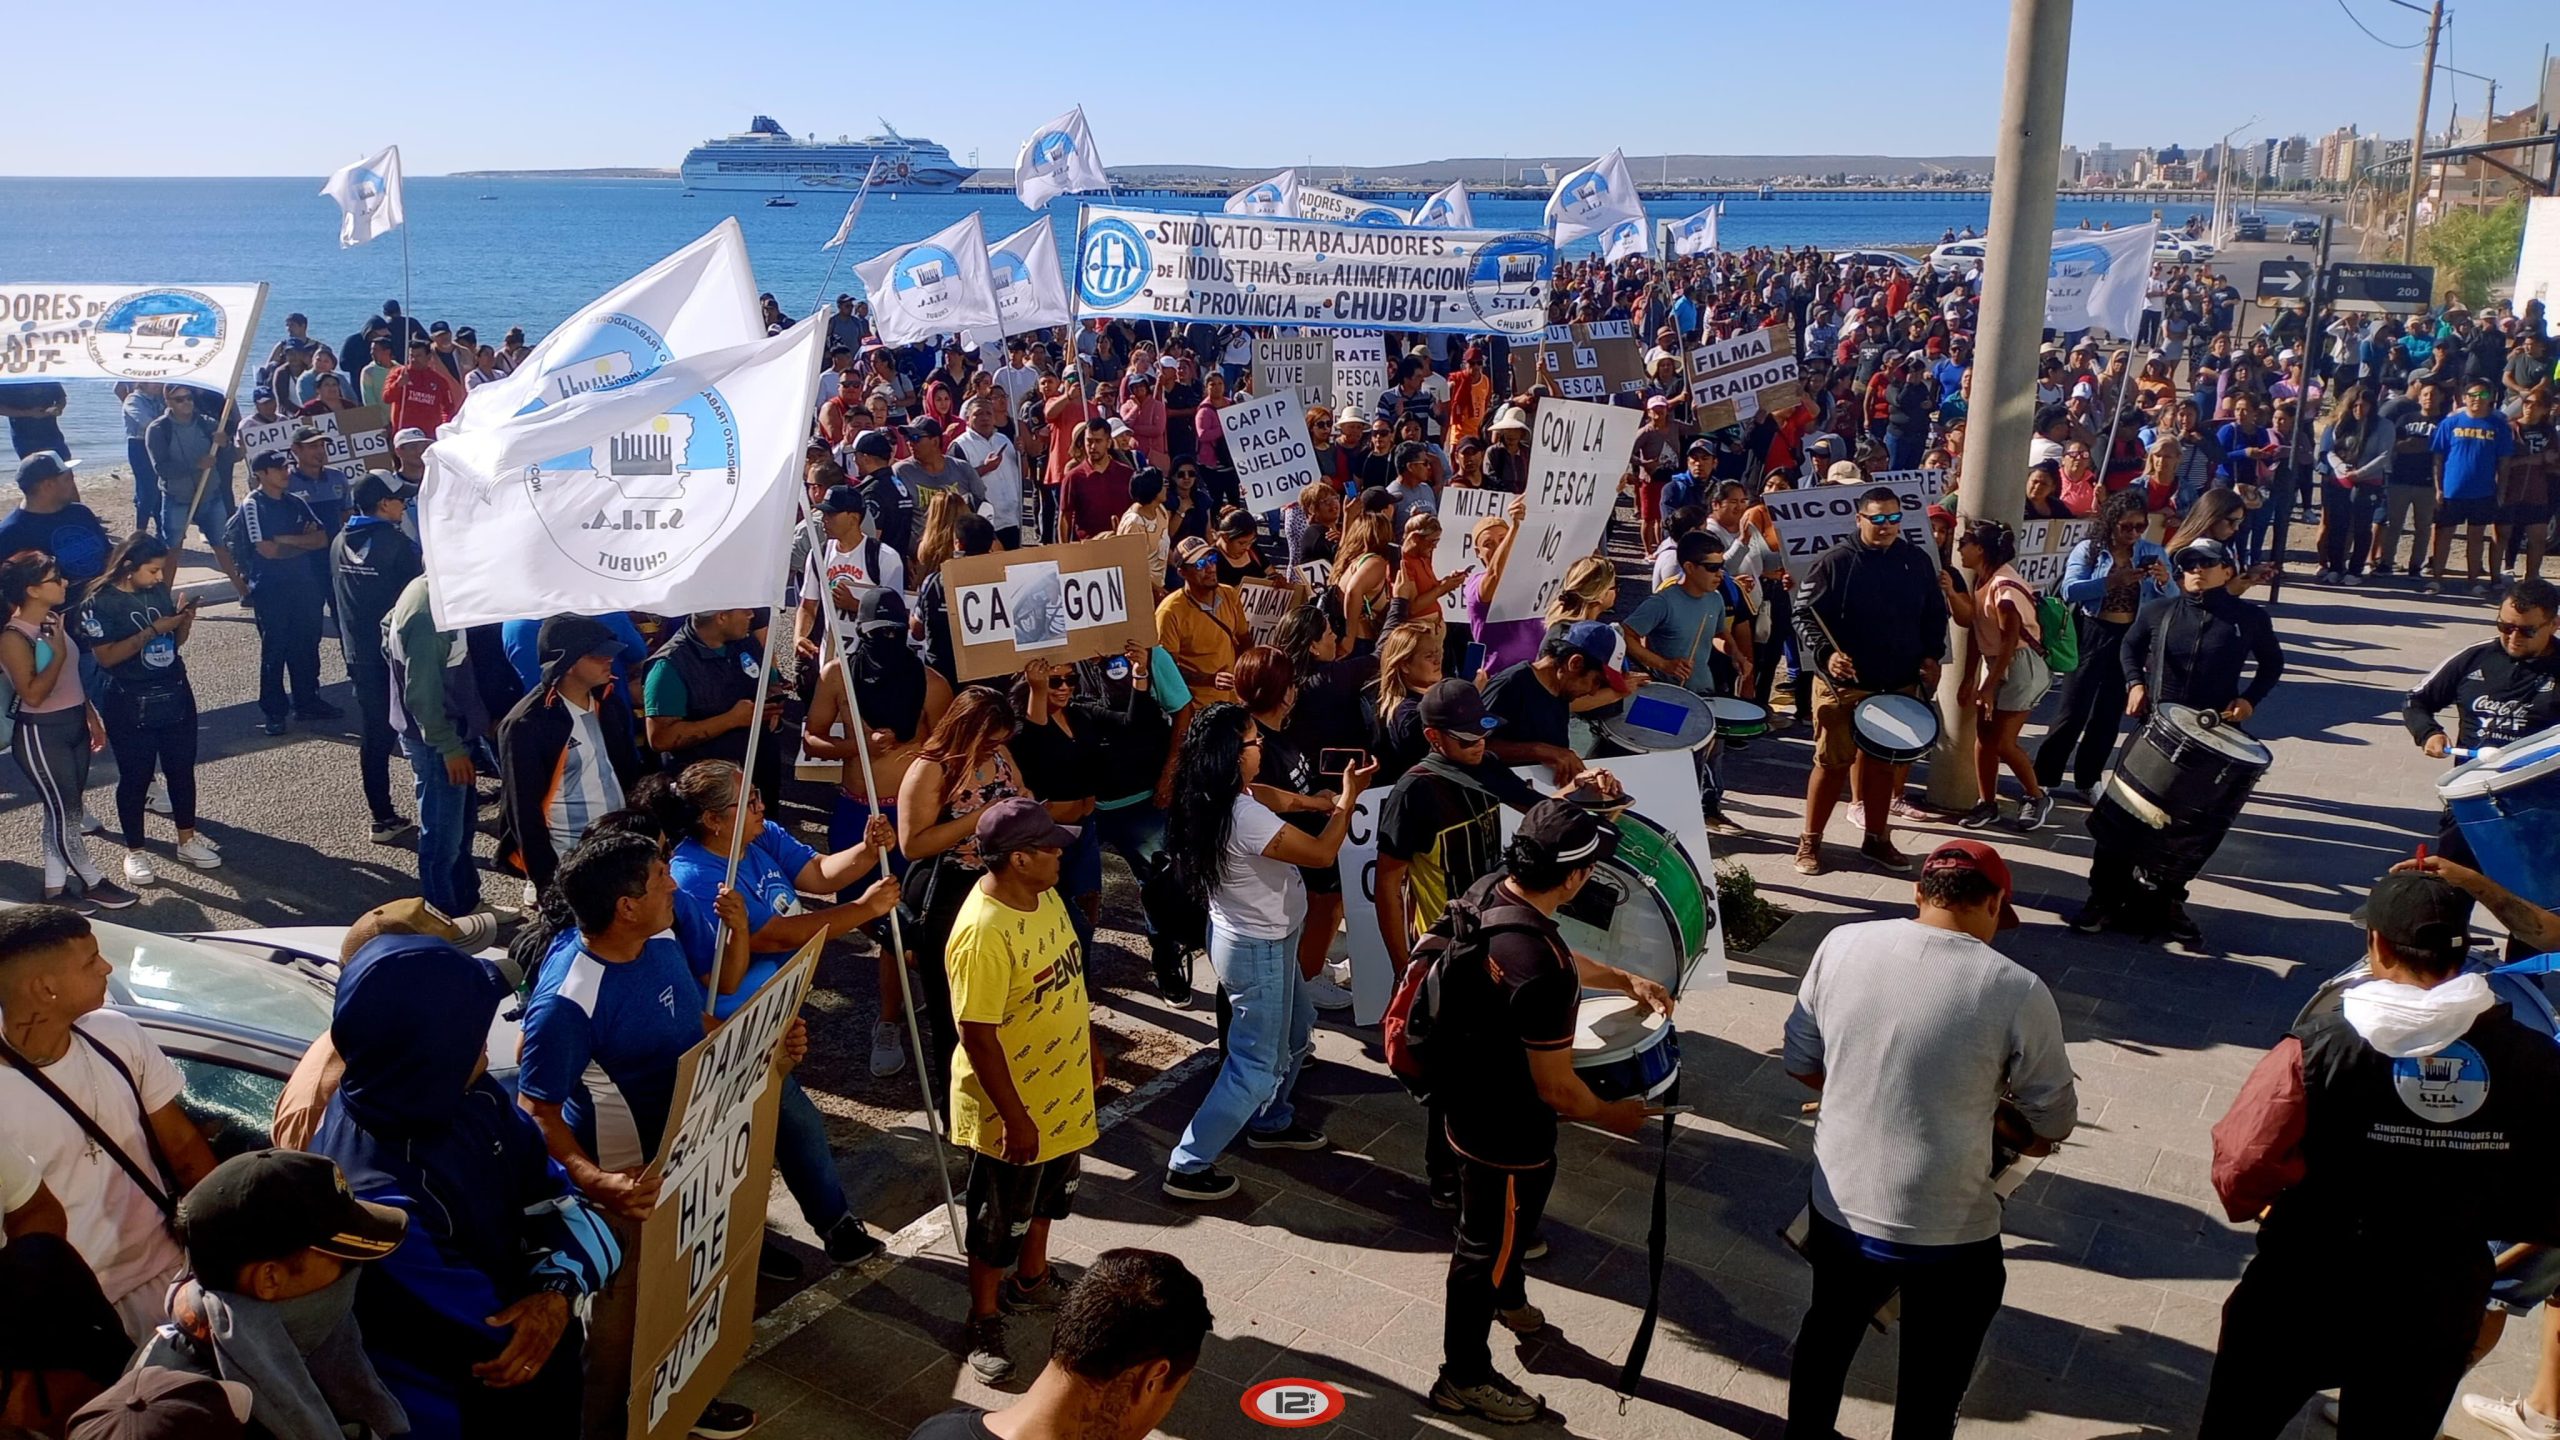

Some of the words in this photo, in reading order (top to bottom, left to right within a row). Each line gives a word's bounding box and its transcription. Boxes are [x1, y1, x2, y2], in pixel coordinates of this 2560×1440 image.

[1156, 221, 1263, 251] SINDICATO
[1274, 226, 1445, 256] TRABAJADORES
[1157, 263, 1174, 279] DE
[1178, 256, 1293, 285] INDUSTRIAS
[1332, 263, 1467, 292] ALIMENTACION
[2397, 286, 2420, 297] 200
[87, 301, 107, 318] DE
[1198, 291, 1298, 319] PROVINCIA
[1304, 305, 1321, 319] DE
[1334, 290, 1448, 323] CHUBUT
[1496, 319, 1534, 330] CHUBUT
[1589, 321, 1631, 337] VIVE
[1260, 342, 1324, 362] CHUBUT
[1332, 350, 1381, 362] RATE
[1575, 350, 1597, 366] LA
[1695, 339, 1767, 373] FILMA
[1267, 366, 1303, 384] VIVE
[1337, 369, 1381, 388] PESCA
[1562, 377, 1605, 396] ESCA
[1695, 363, 1798, 404] TRAIDOR
[1303, 387, 1321, 405] LA
[1346, 391, 1364, 408] SE
[1226, 400, 1287, 431] CAPIP
[326, 439, 348, 456] DE
[353, 432, 387, 452] LOS
[1239, 426, 1291, 452] PAGA
[1540, 411, 1576, 458] CON
[1583, 415, 1605, 453] LA
[1236, 442, 1307, 476] SUELDO
[1252, 470, 1313, 499] DIGNO
[1541, 470, 1598, 506] PESCA
[1536, 524, 1563, 563] NO
[690, 966, 808, 1107] DAMIAN
[662, 1039, 779, 1179] SANTOS
[2367, 1132, 2422, 1147] INDUSTRIAS
[2448, 1141, 2511, 1151] ALIMENTACION
[2374, 1123, 2423, 1136] SINDICATO
[2425, 1129, 2491, 1141] TRABAJADORES
[2492, 1132, 2504, 1140] DE
[680, 1121, 751, 1247] HIJO
[691, 1208, 726, 1302] DE
[649, 1284, 721, 1422] PUTA
